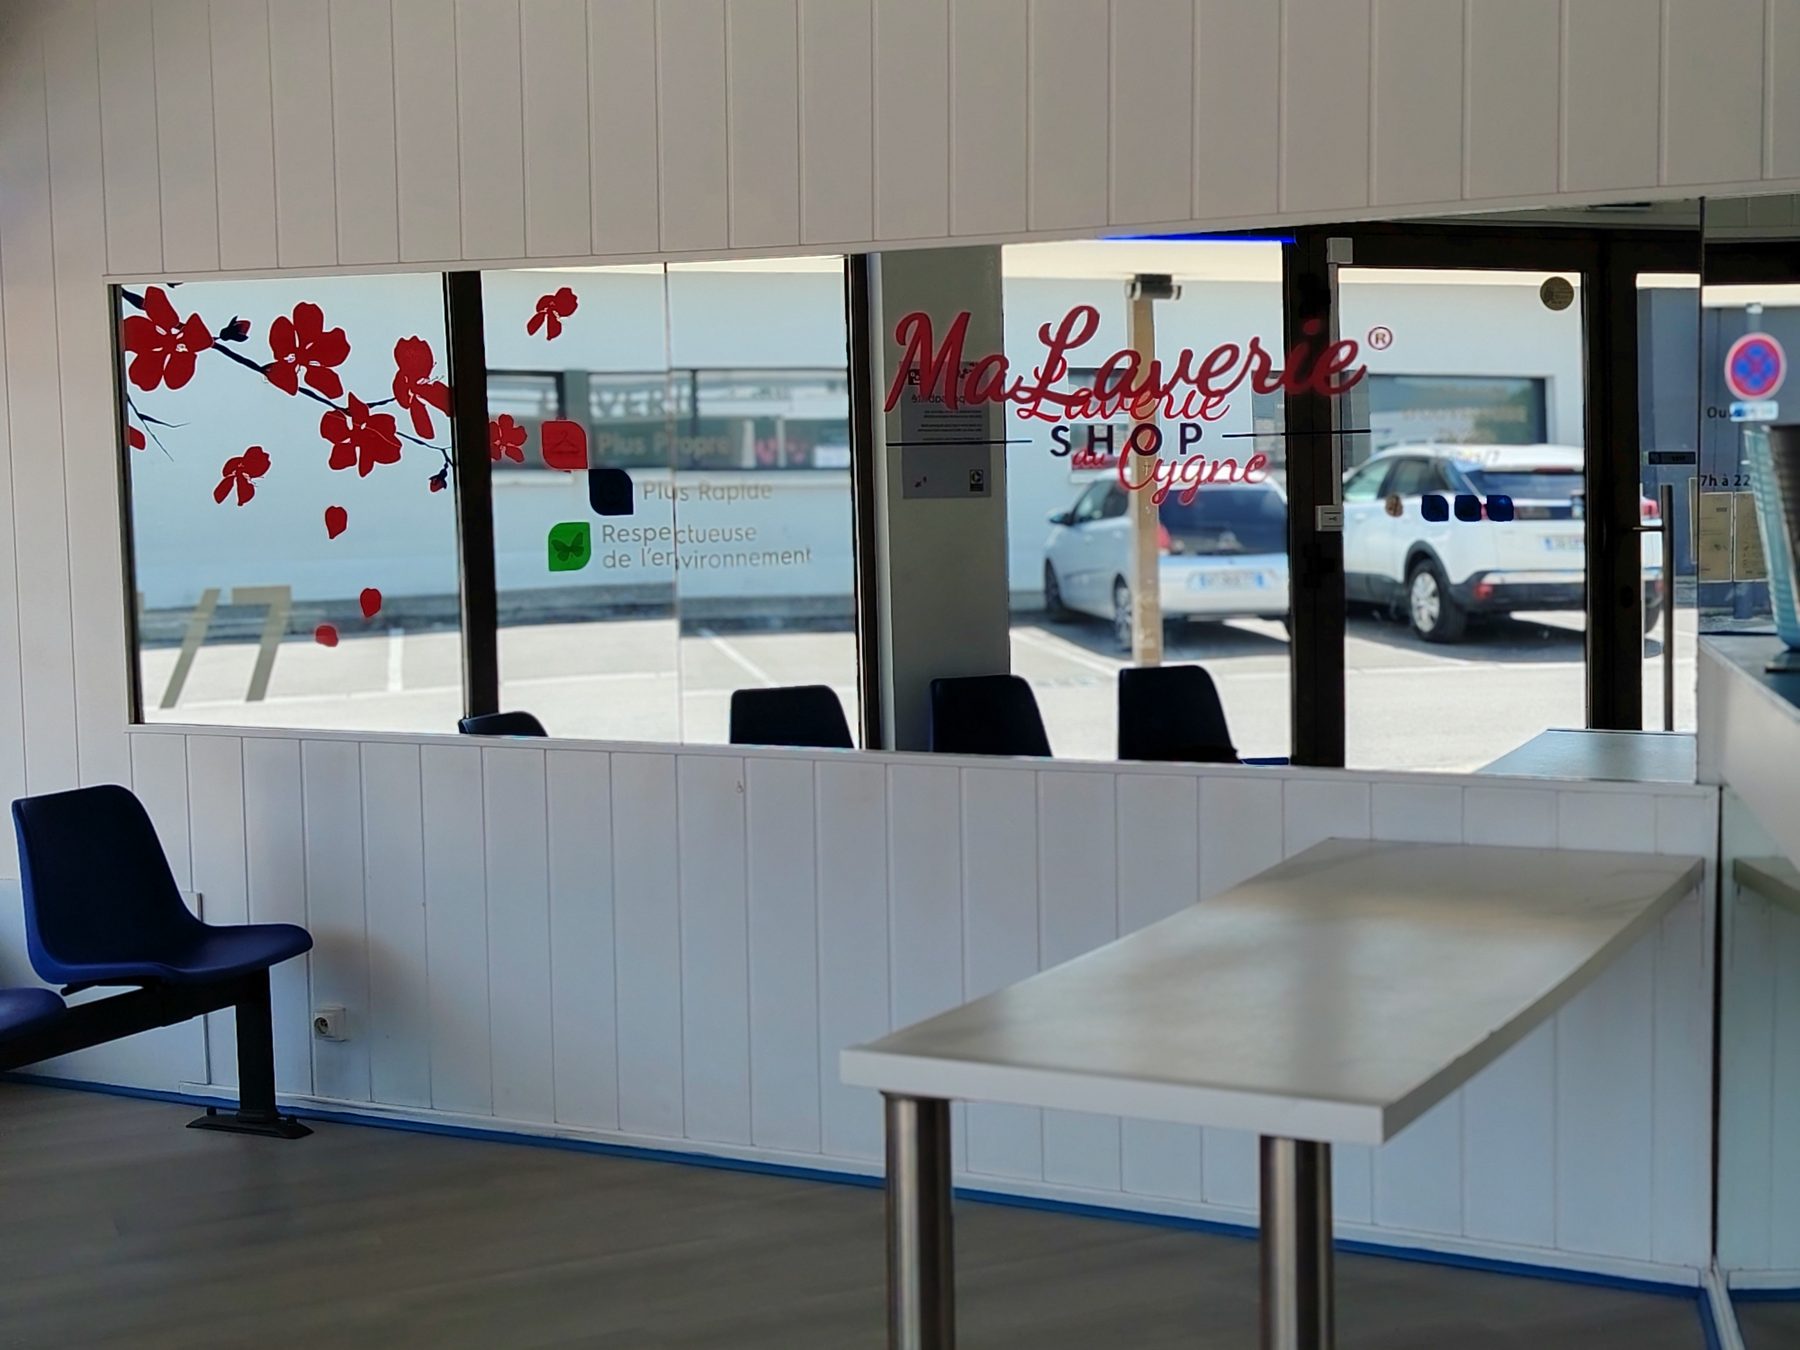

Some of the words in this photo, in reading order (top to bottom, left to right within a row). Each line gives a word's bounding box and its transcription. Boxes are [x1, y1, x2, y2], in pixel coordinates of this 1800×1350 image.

[598, 431, 647, 456] Plus
[1050, 422, 1204, 457] SHOP
[1118, 427, 1269, 505] Cygne
[643, 482, 691, 502] Plus
[698, 481, 775, 504] Rapide
[1734, 474, 1751, 487] 22
[601, 523, 759, 547] Respectueuse
[602, 549, 632, 569] de
[640, 547, 813, 570] l'environnement
